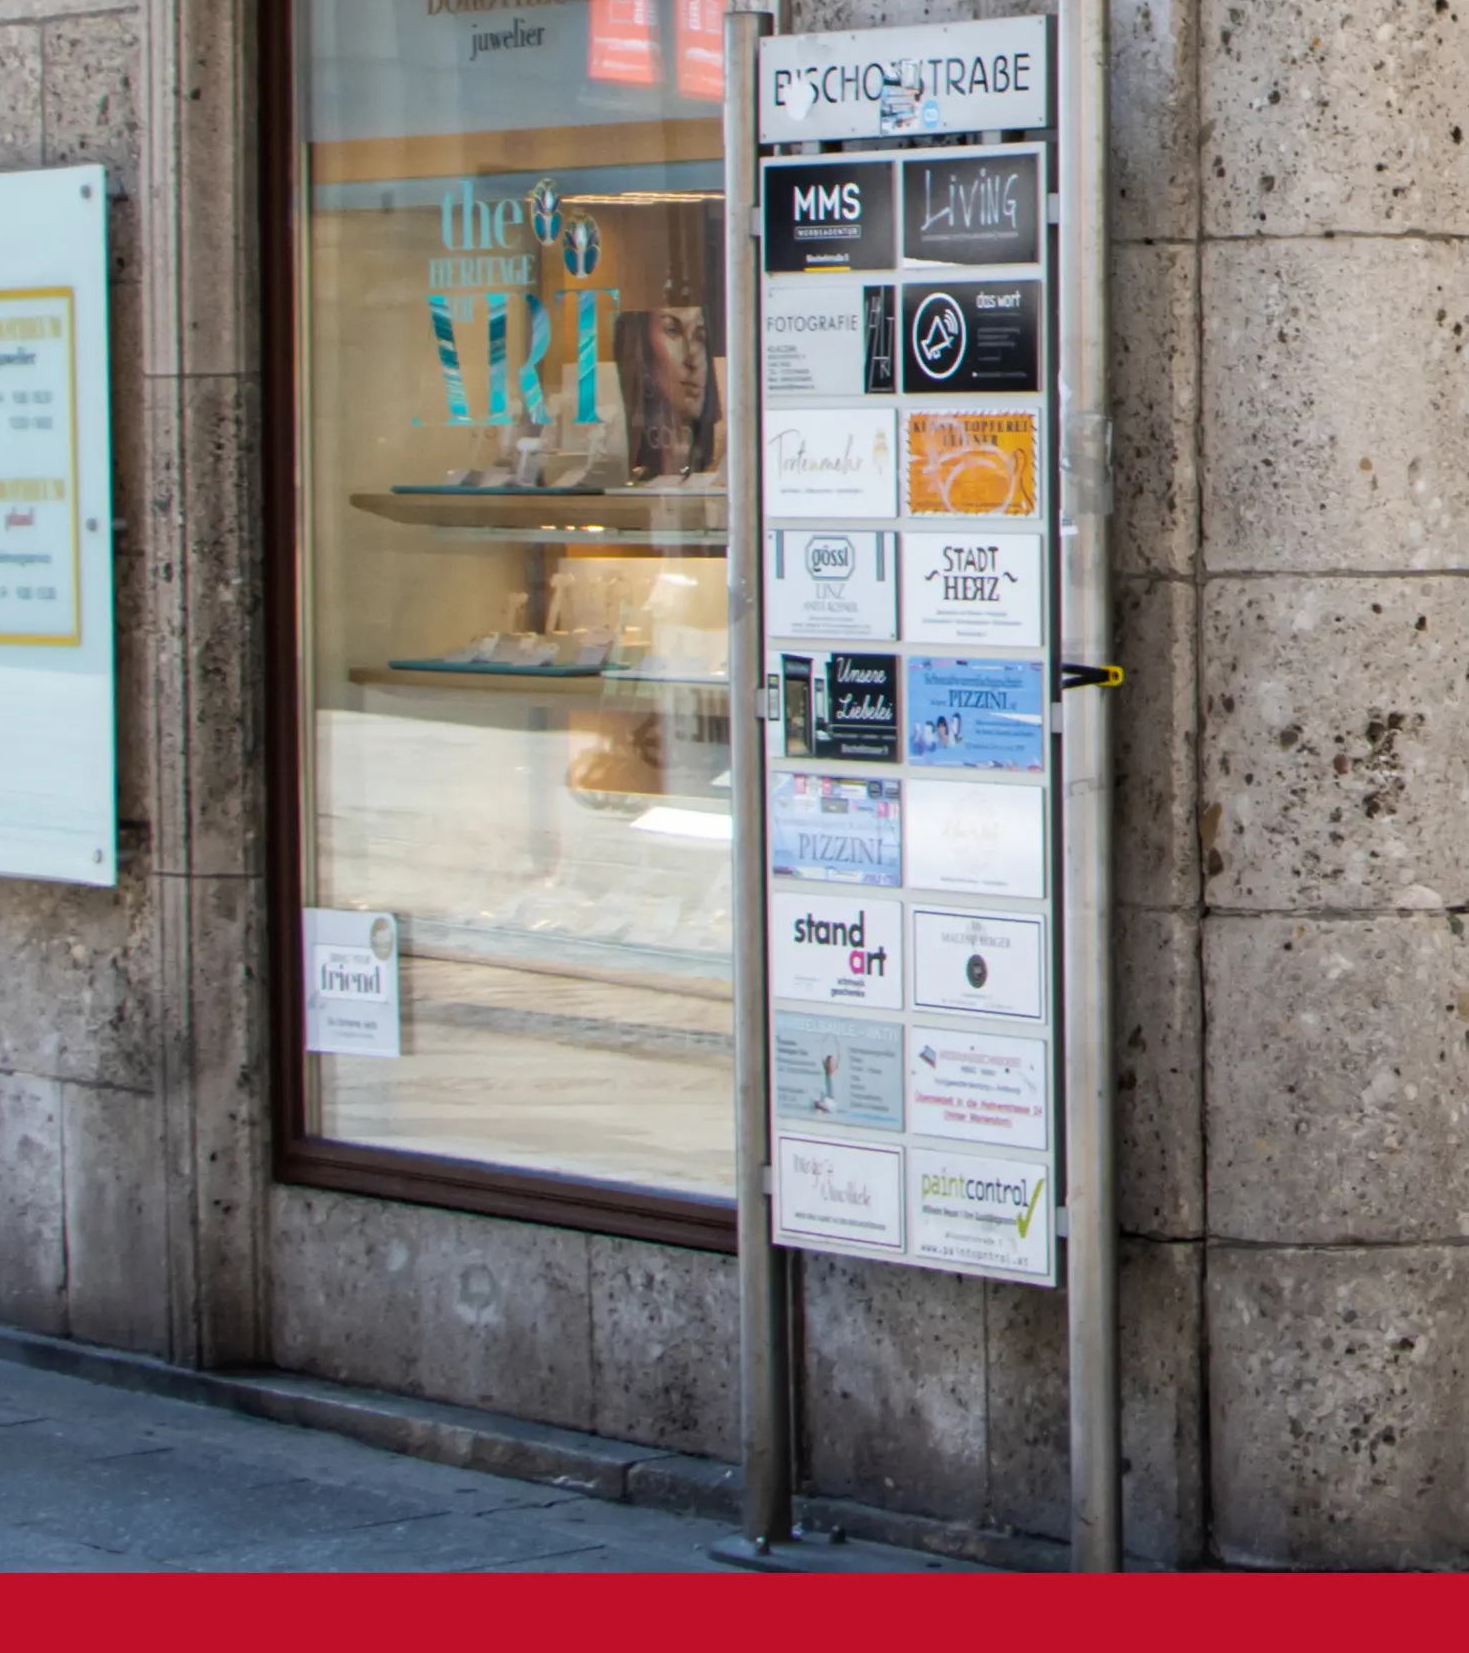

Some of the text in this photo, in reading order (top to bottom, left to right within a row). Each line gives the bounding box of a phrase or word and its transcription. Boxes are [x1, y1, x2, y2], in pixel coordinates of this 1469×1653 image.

[469, 16, 545, 62] juwelier
[439, 180, 524, 253] the
[793, 182, 861, 221] MMS
[429, 255, 536, 289] HERITAGE
[766, 315, 859, 333] FOTOGRAFIE
[811, 545, 849, 572] gössl
[942, 545, 1000, 573] STADT
[836, 657, 887, 684] Unsere
[948, 689, 1008, 710] PIZZINI
[797, 832, 884, 866] PIZZINI
[793, 909, 865, 949] stand
[849, 945, 887, 977] art
[320, 963, 382, 995] friend
[921, 1168, 1029, 1208] paintcontrol
